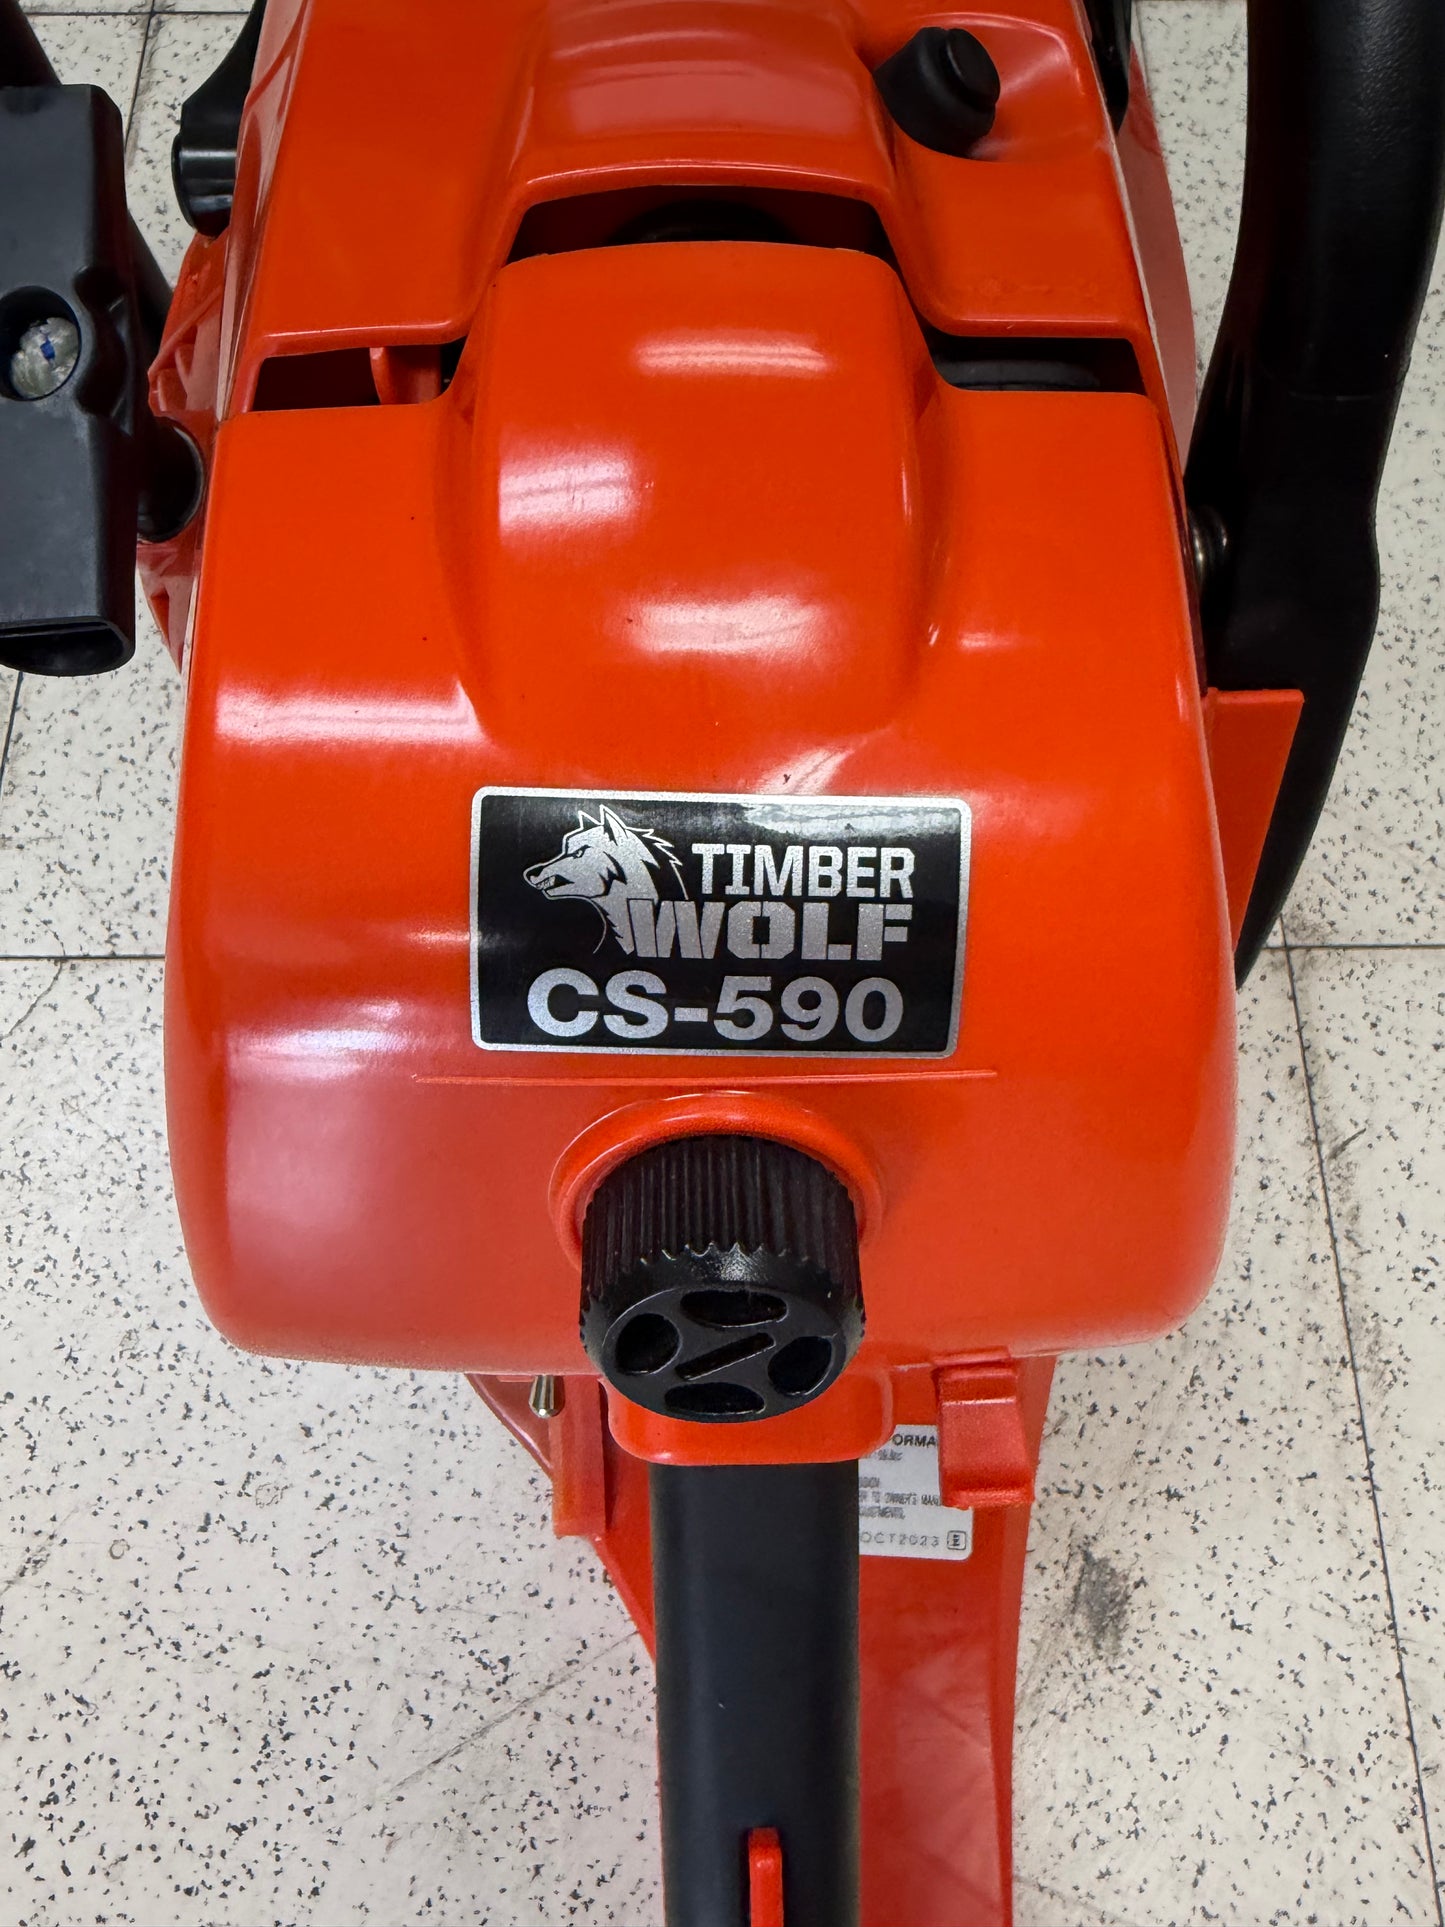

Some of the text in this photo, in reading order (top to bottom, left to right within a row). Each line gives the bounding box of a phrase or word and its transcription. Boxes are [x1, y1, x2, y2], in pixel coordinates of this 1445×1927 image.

[691, 843, 916, 898] TIMBER
[627, 899, 913, 961] WOLF
[526, 967, 904, 1042] CS-590
